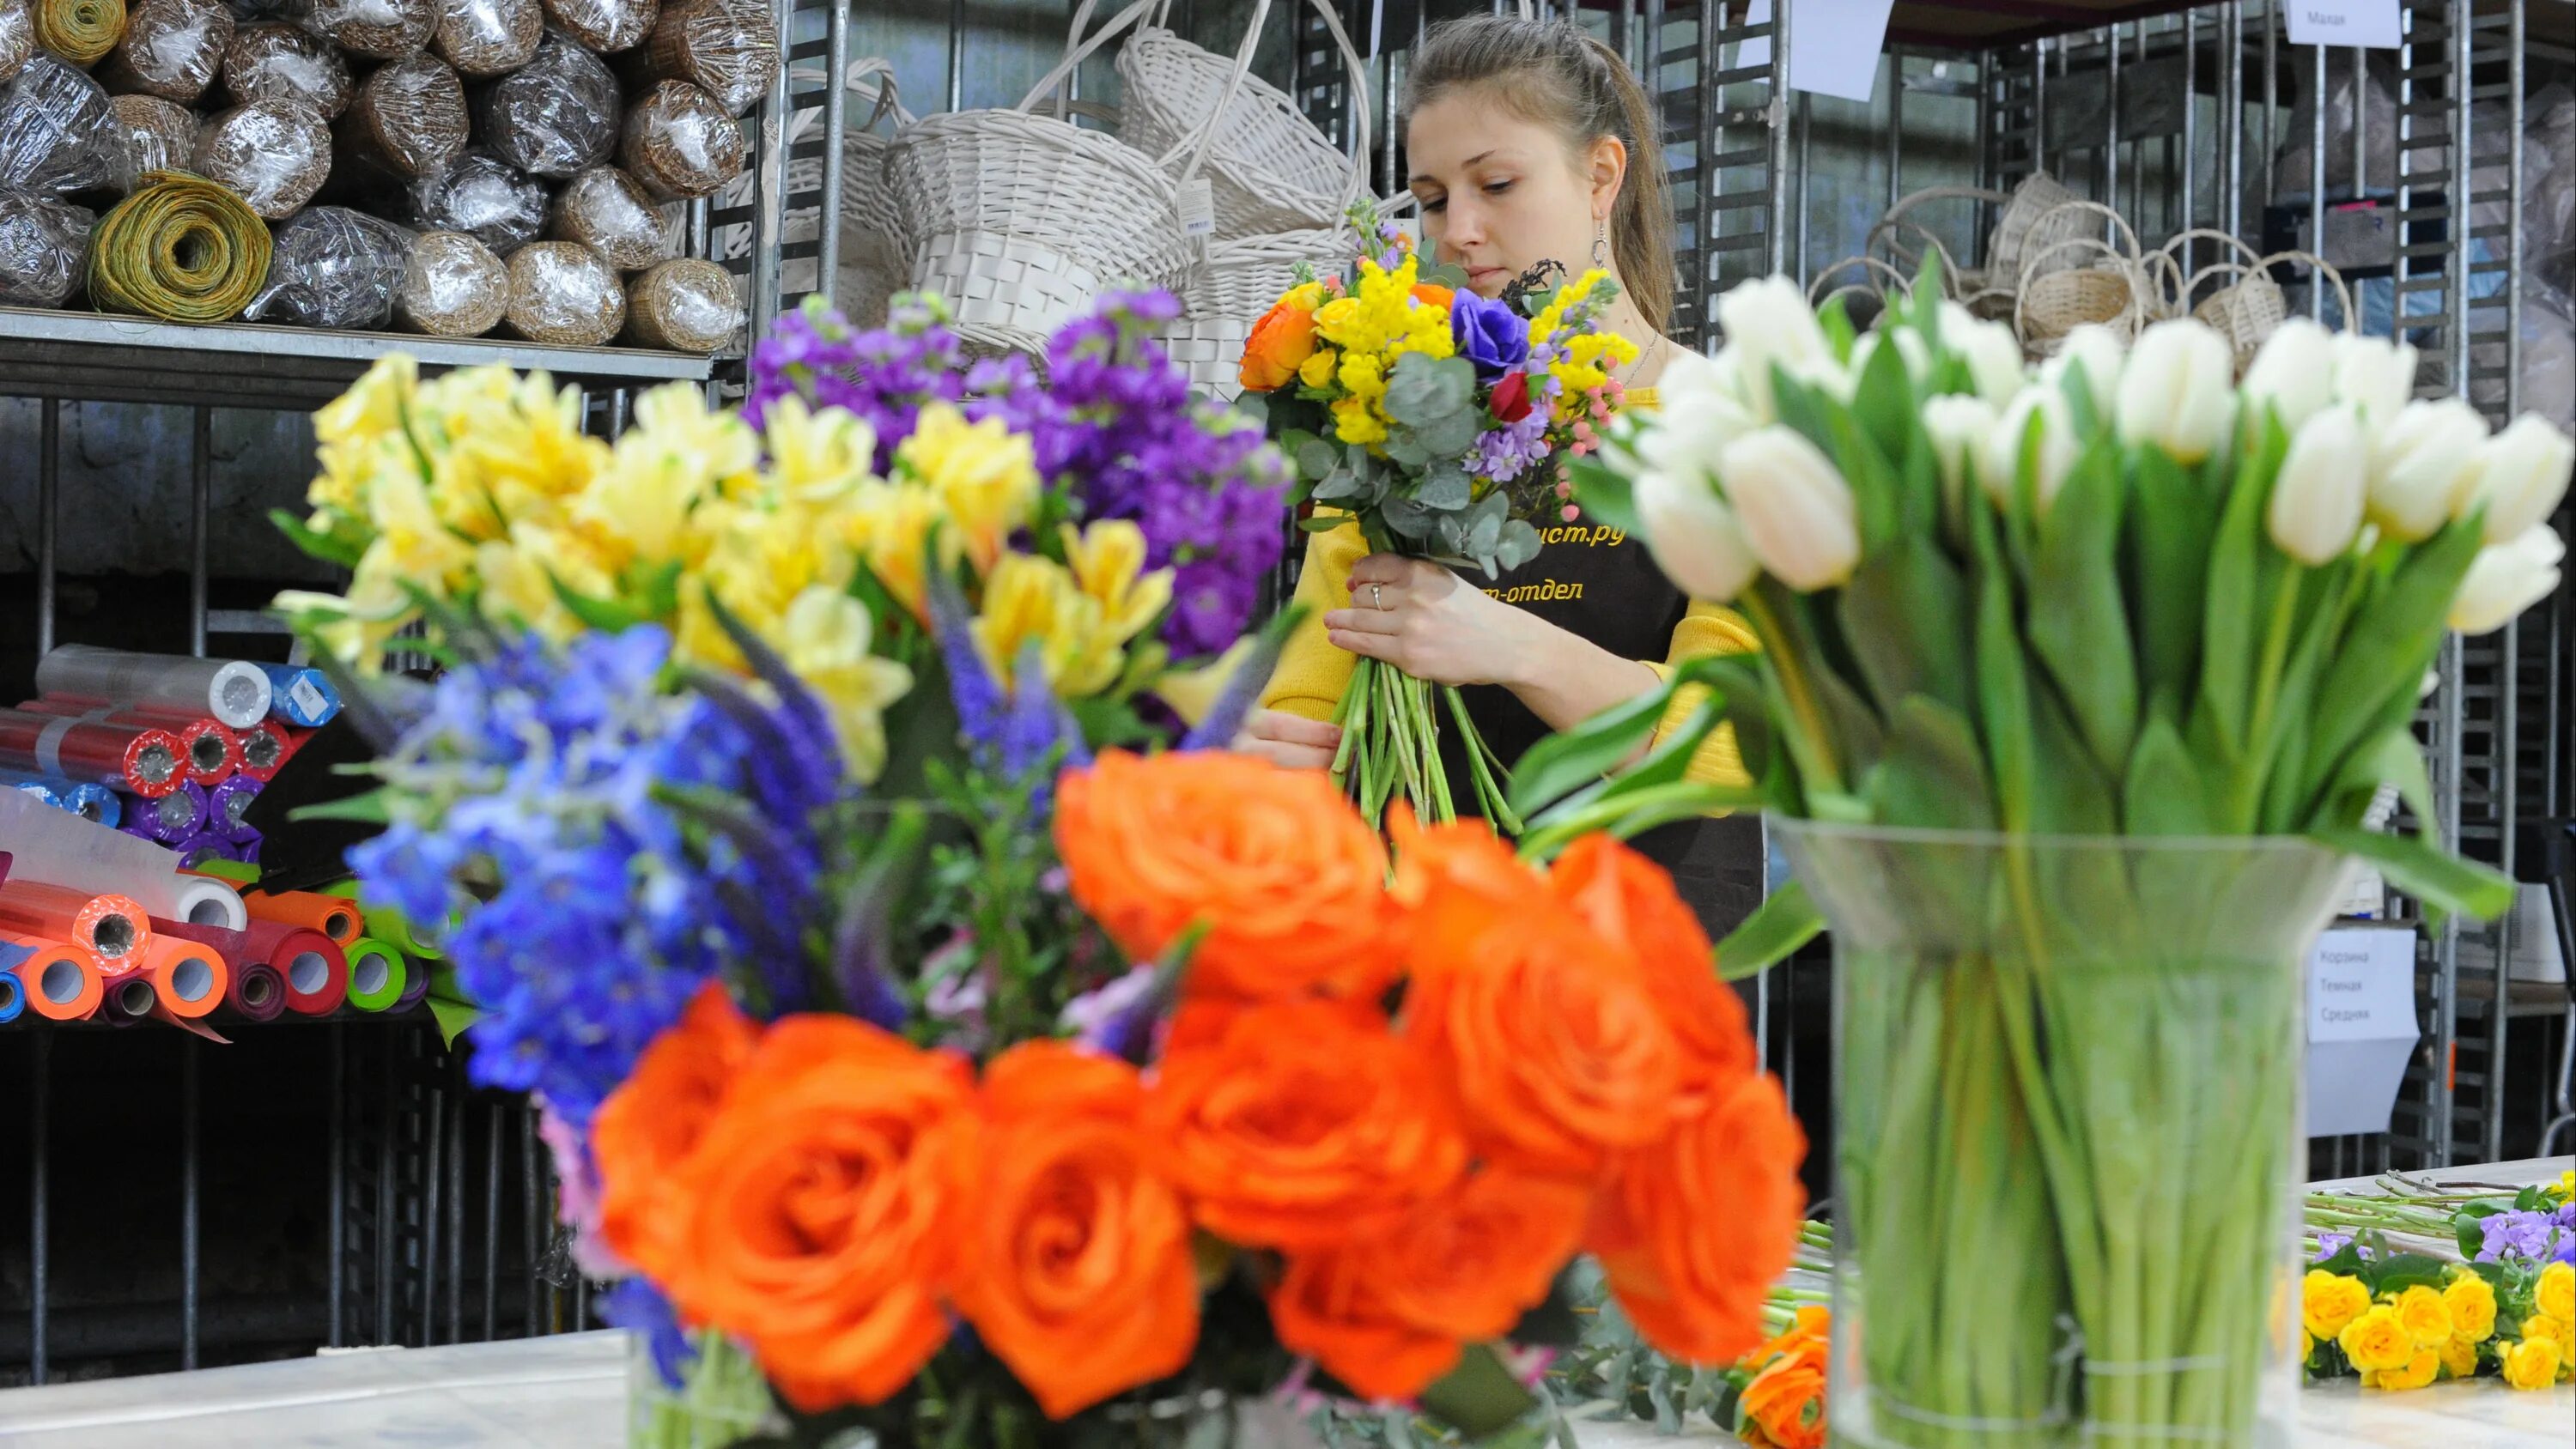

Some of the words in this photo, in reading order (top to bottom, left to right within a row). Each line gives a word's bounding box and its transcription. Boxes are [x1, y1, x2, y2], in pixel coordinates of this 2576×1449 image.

[2306, 11, 2346, 26] Малая
[2320, 950, 2369, 964] Корзина
[2320, 978, 2362, 991] Темная
[2321, 1007, 2370, 1022] Средняя
